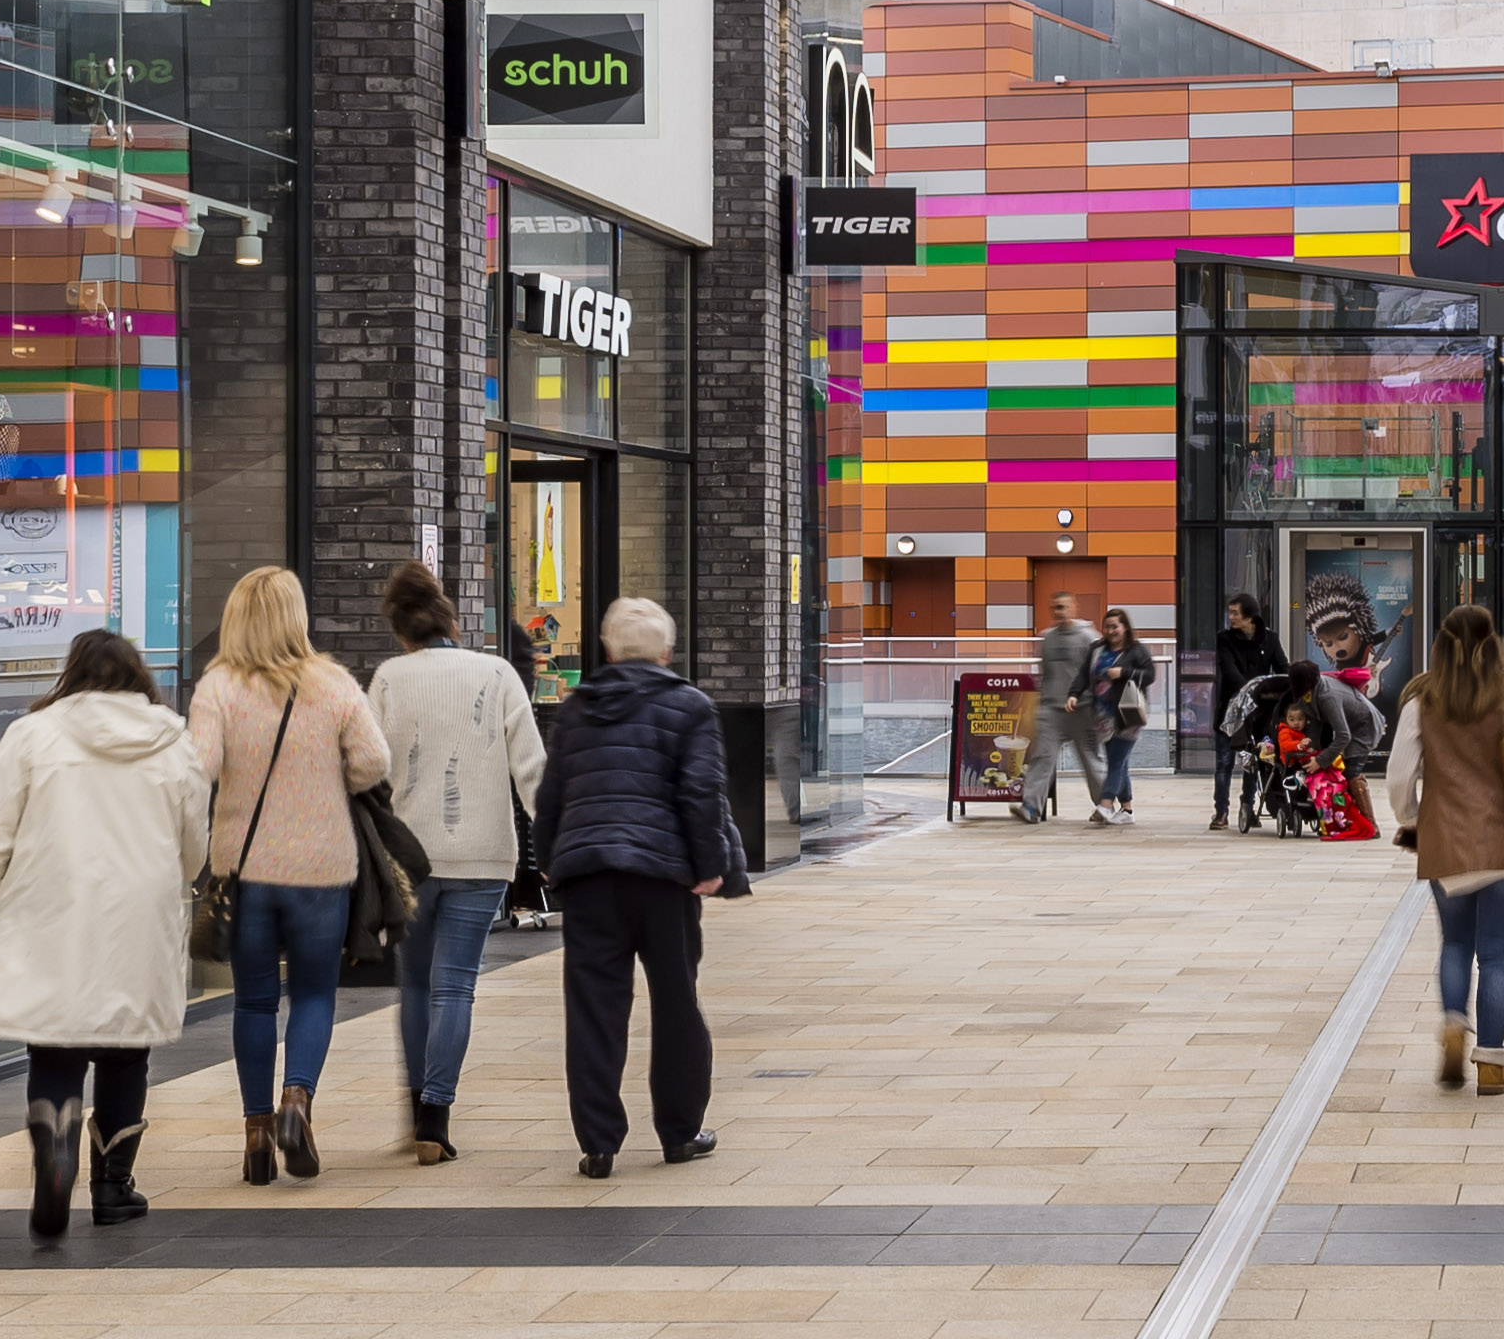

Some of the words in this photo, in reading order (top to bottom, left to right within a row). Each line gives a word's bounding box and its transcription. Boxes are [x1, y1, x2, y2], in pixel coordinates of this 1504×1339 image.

[504, 53, 628, 87] schuh
[812, 216, 911, 234] TIGER
[539, 274, 631, 358] TIGER
[987, 679, 1019, 687] COSTA
[973, 722, 1010, 731] SMOOTHIE
